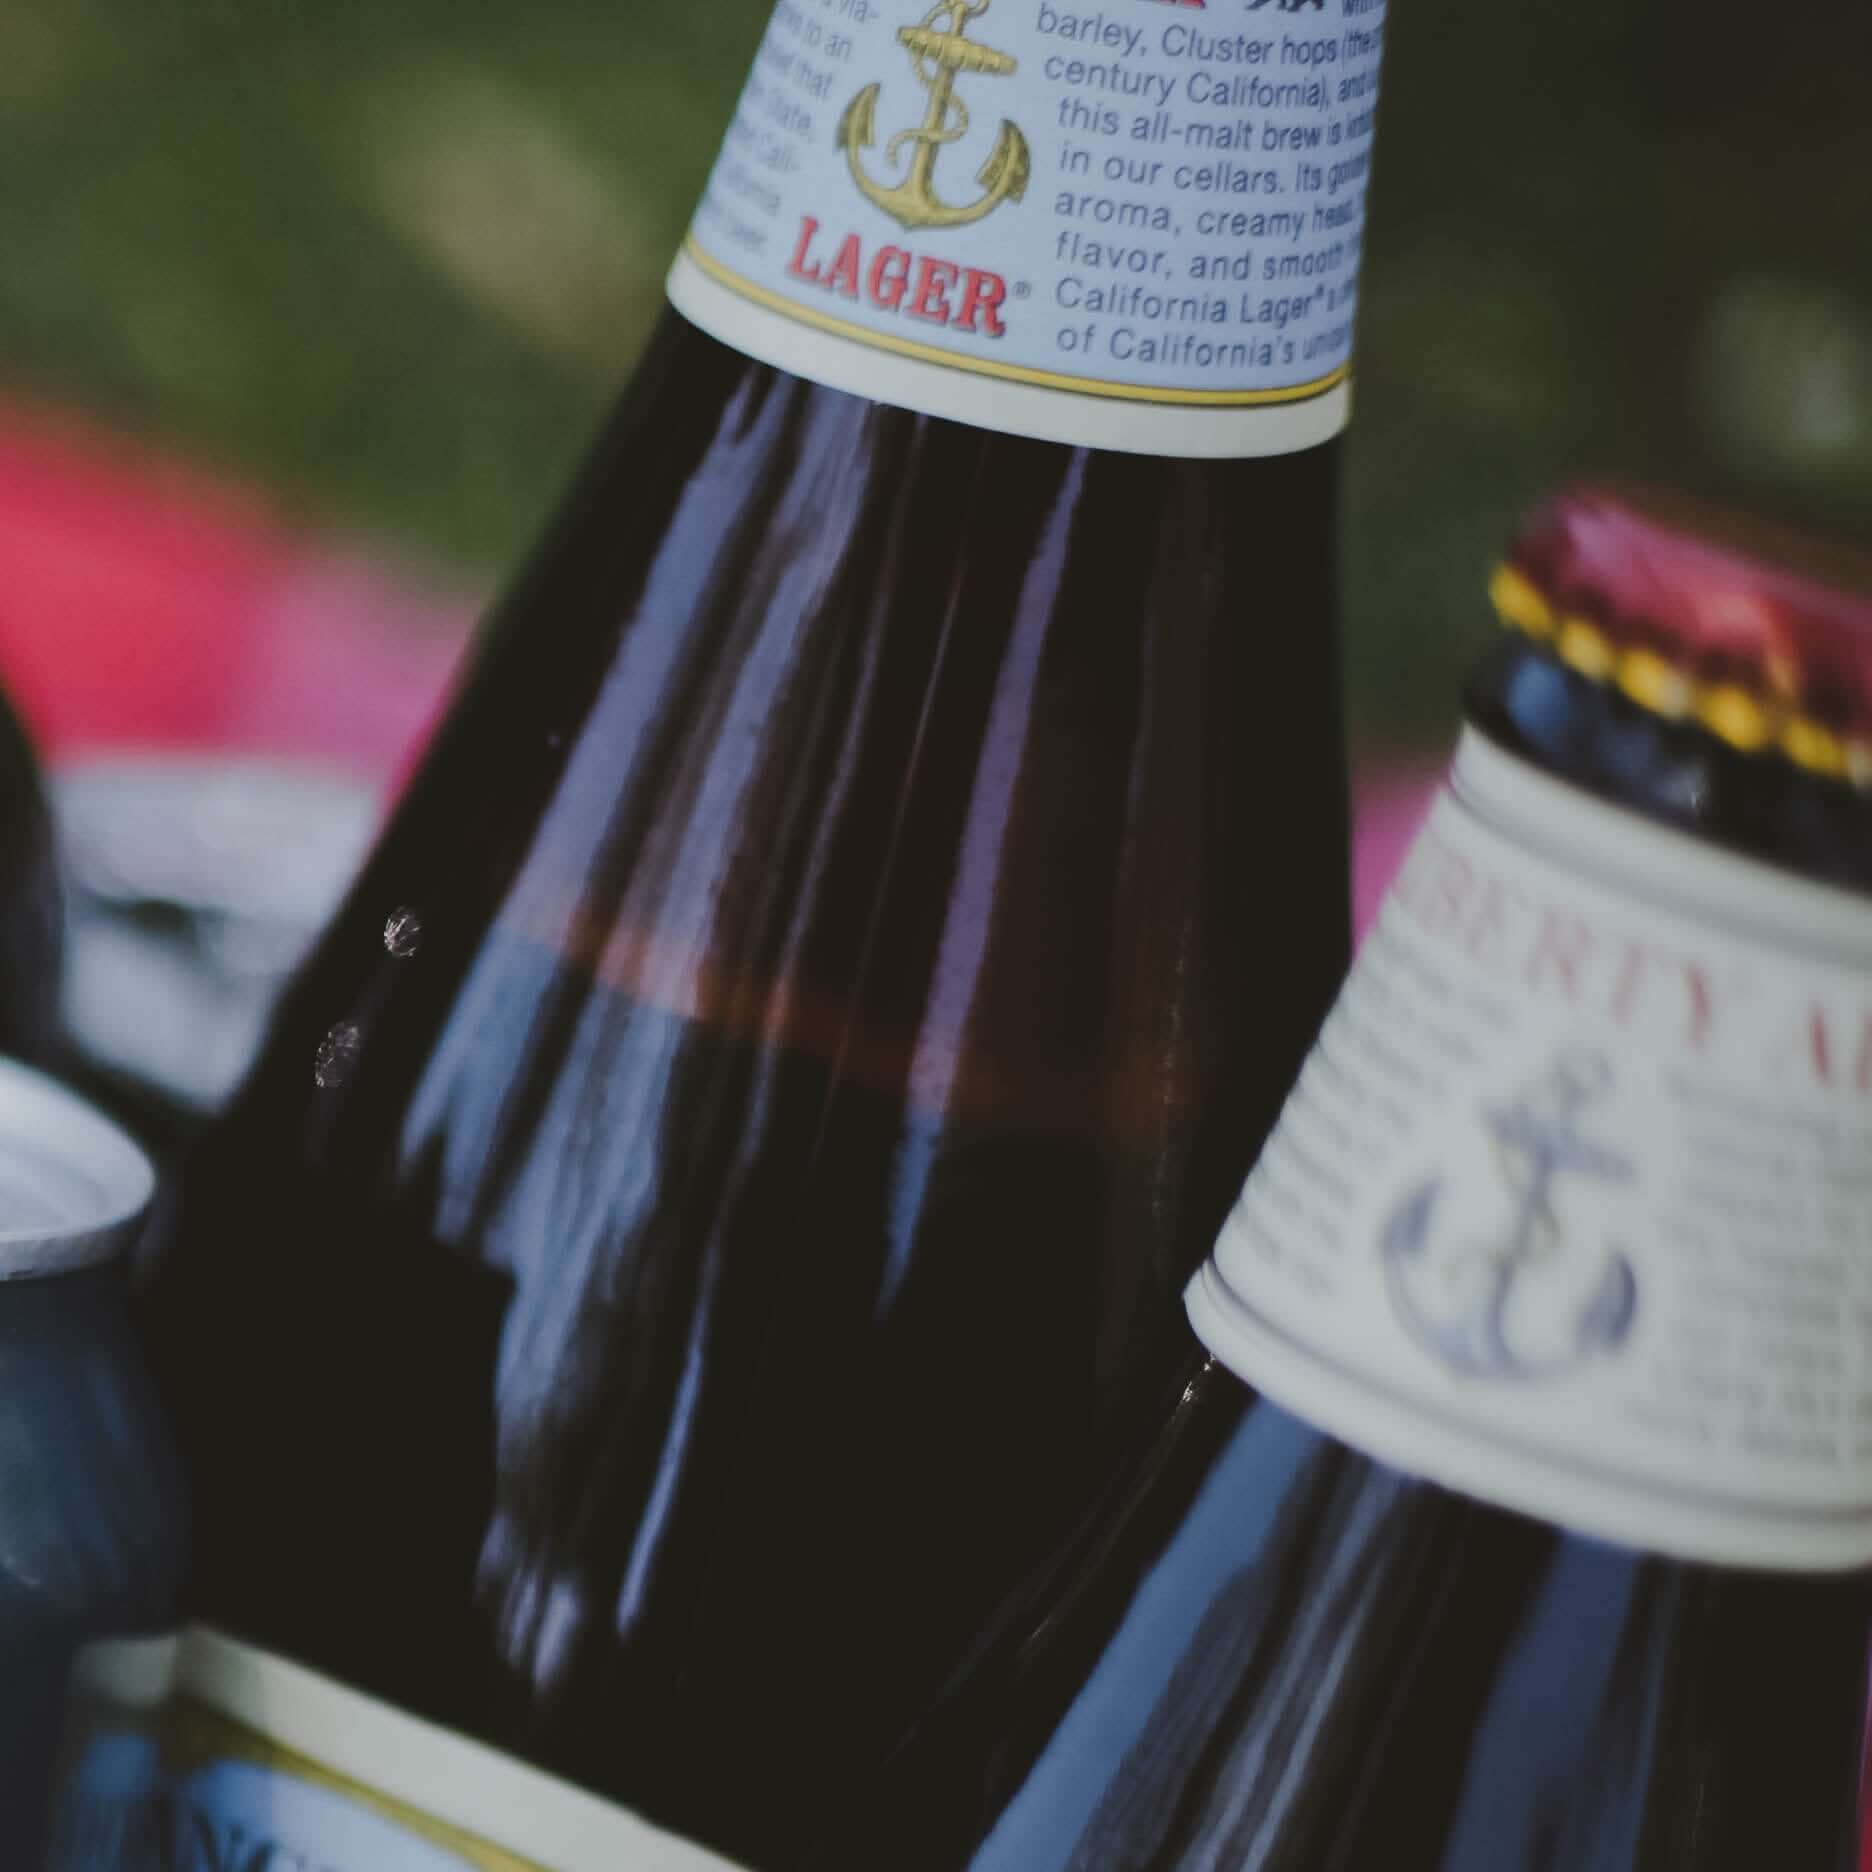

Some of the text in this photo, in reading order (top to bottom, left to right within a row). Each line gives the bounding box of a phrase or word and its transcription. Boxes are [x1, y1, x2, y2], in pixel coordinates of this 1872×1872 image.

[1037, 5, 1147, 57] barley,
[1161, 25, 1274, 64] Cluster
[1280, 34, 1338, 71] hops
[1044, 55, 1176, 106] century
[1058, 97, 1120, 136] this
[1131, 111, 1254, 151] all-malt
[1260, 119, 1322, 151] brew
[1059, 142, 1090, 174] in
[1104, 155, 1164, 185] our
[1173, 161, 1285, 195] cellars.
[1055, 190, 1182, 237] aroma,
[1196, 206, 1306, 243] creamy
[1056, 230, 1173, 281] flavor,
[1189, 252, 1251, 281] and
[1056, 277, 1228, 323] California
[1057, 323, 1098, 353] of
[1109, 328, 1296, 368] California's
